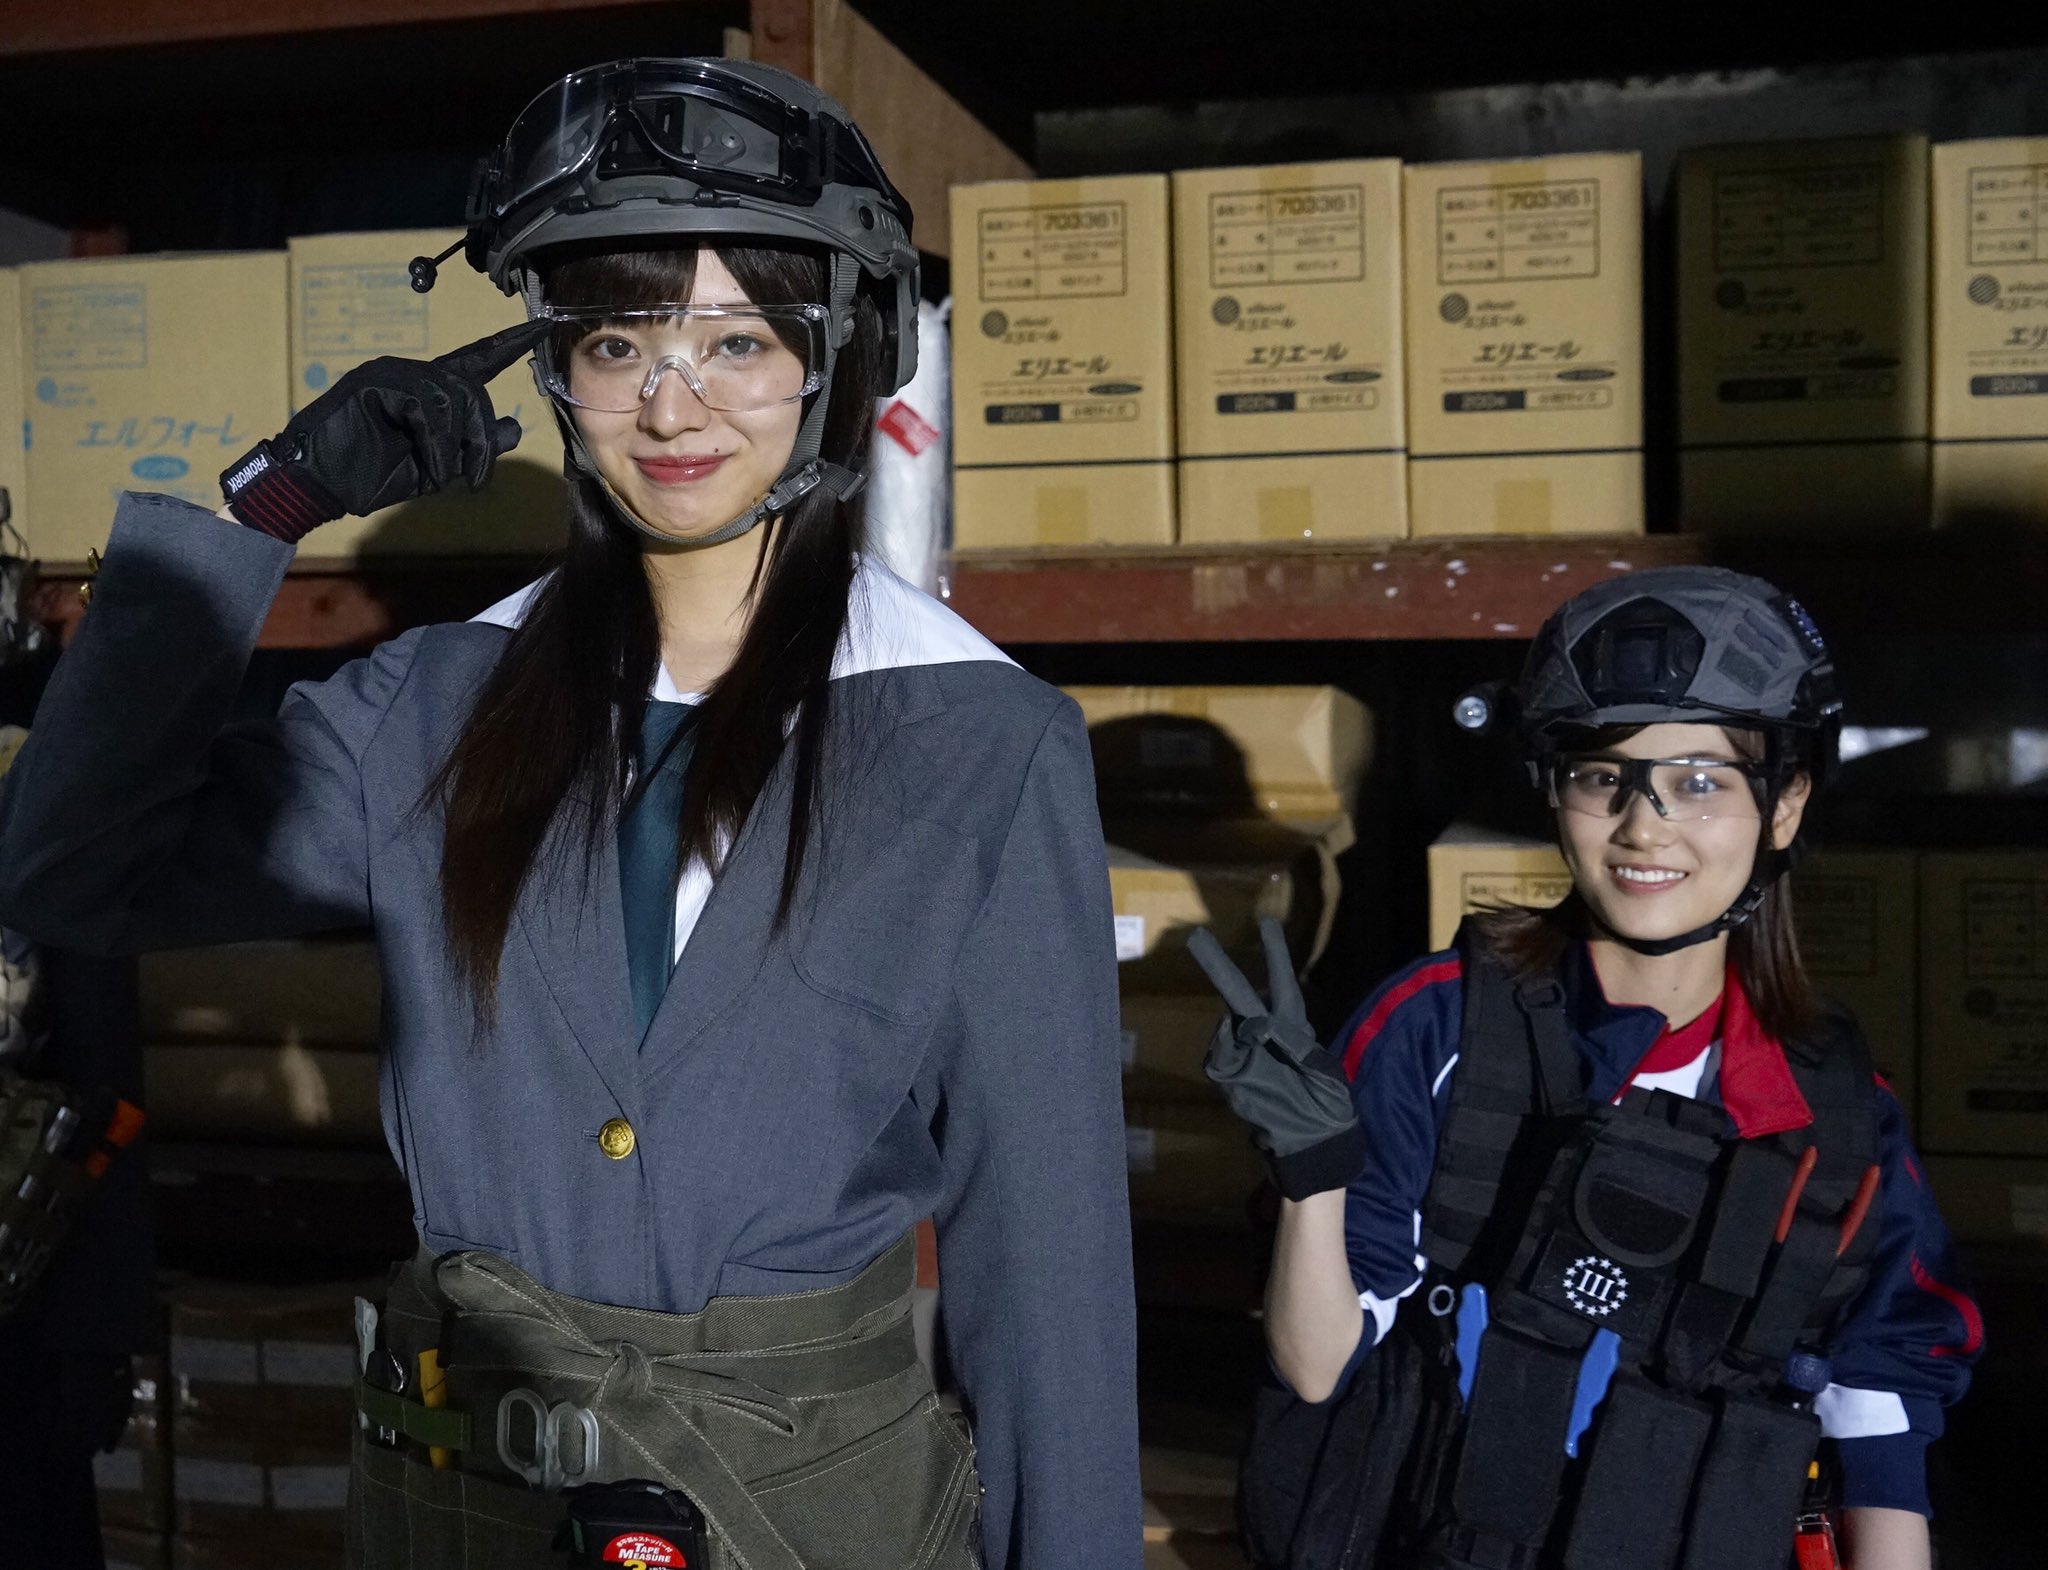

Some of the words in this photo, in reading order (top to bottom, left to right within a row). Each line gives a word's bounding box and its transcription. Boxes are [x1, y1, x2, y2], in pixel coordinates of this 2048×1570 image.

[1507, 187, 1592, 210] 703361
[1246, 341, 1349, 369] エリエール
[1473, 340, 1582, 367] エリエール
[1012, 354, 1111, 381] エリエール
[75, 414, 250, 449] エルフォーレ
[227, 454, 269, 494] PROWORK
[618, 1548, 671, 1563] MEASURE
[634, 1542, 660, 1554] TAPE
